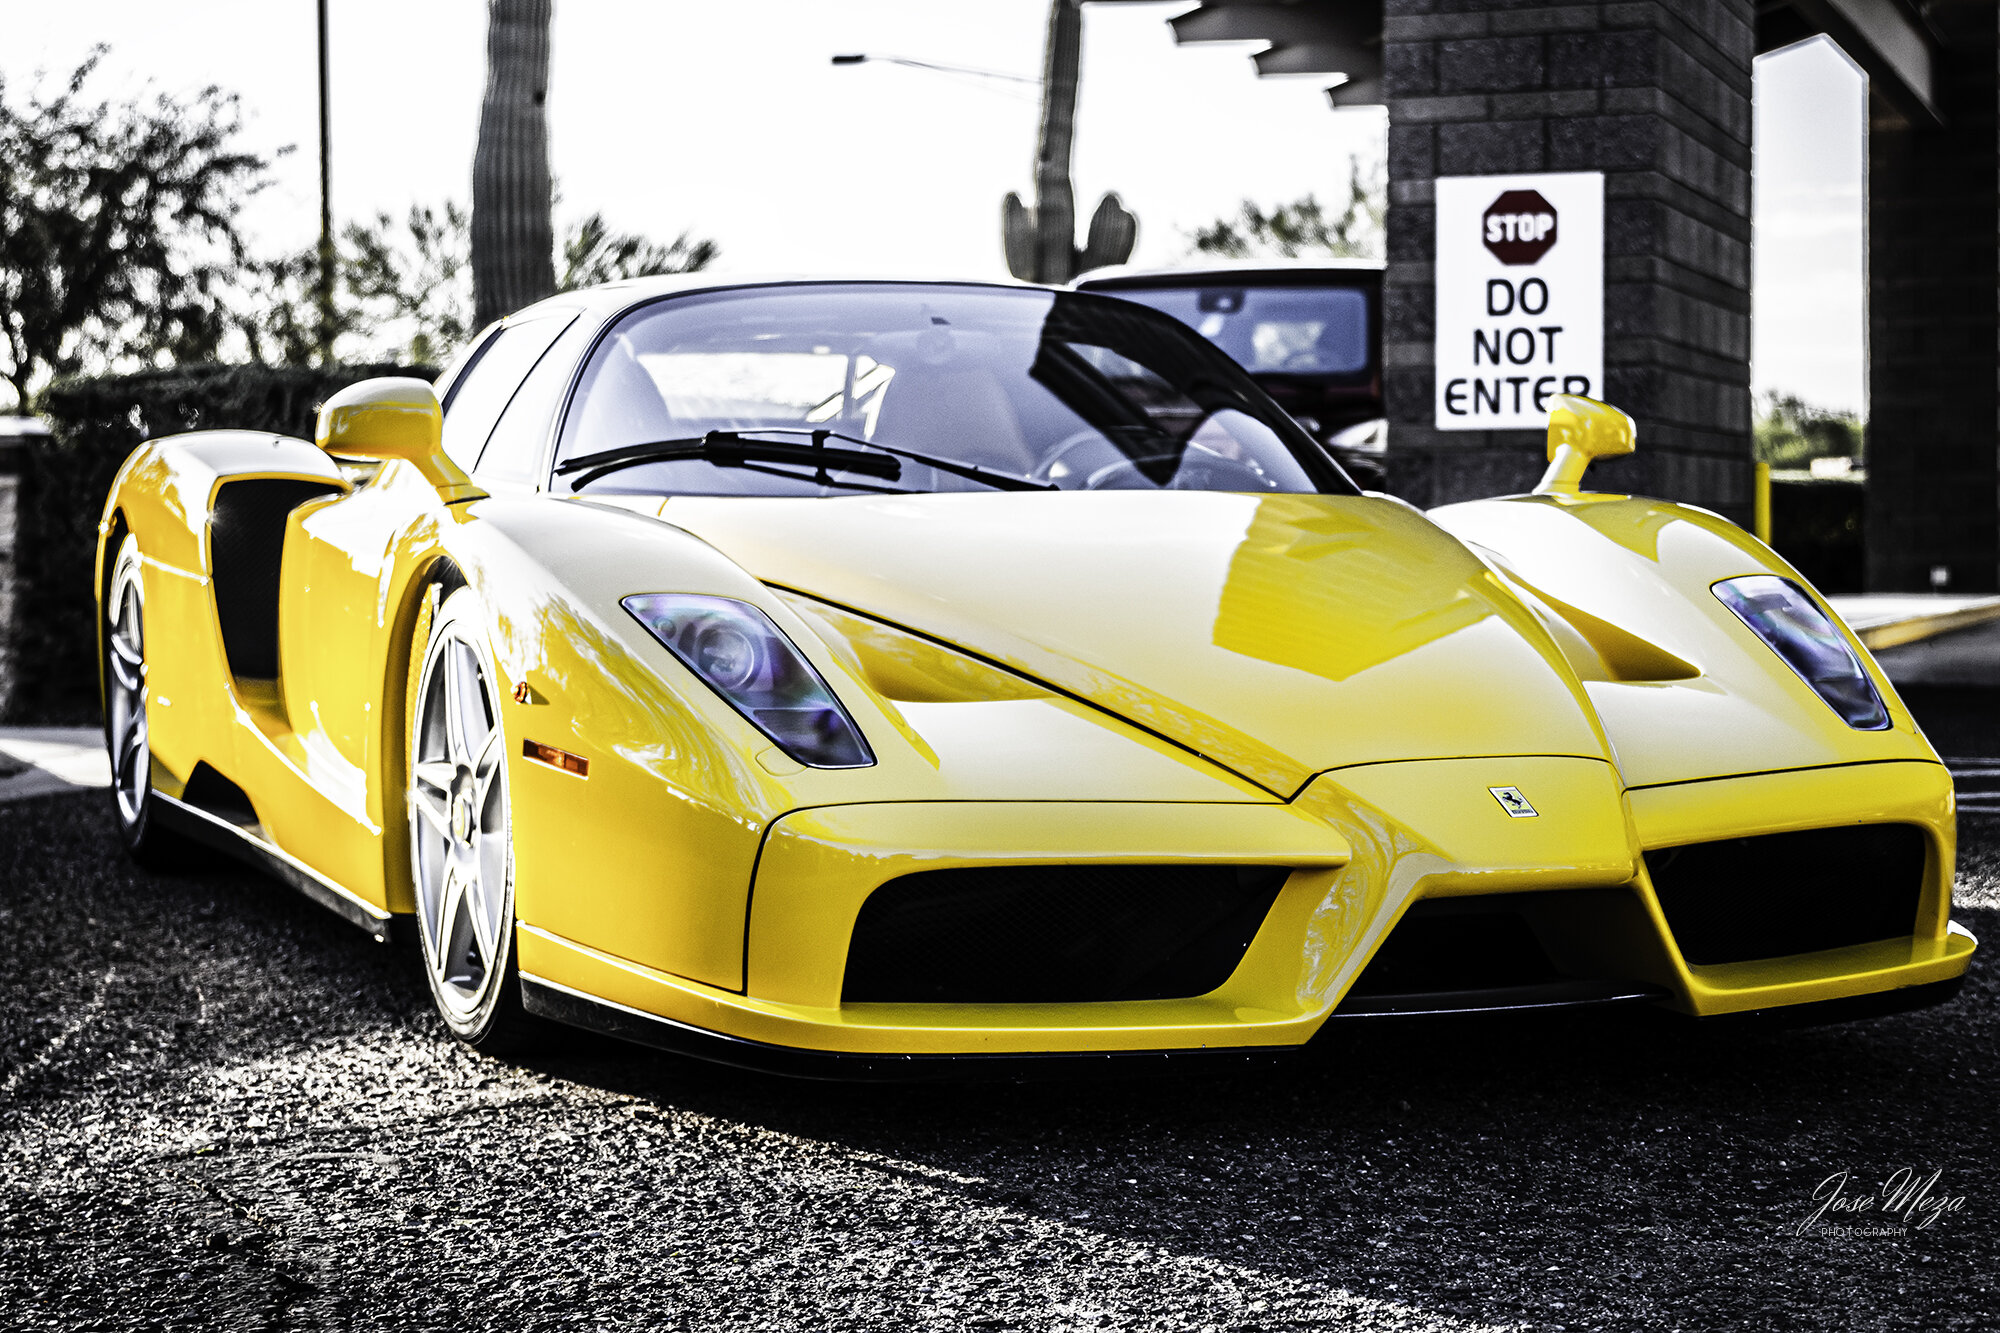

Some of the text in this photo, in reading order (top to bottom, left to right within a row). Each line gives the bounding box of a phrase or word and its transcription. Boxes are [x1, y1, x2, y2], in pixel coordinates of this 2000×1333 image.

[1486, 213, 1554, 243] STOP
[1487, 277, 1549, 316] DO
[1473, 326, 1563, 366] NOT
